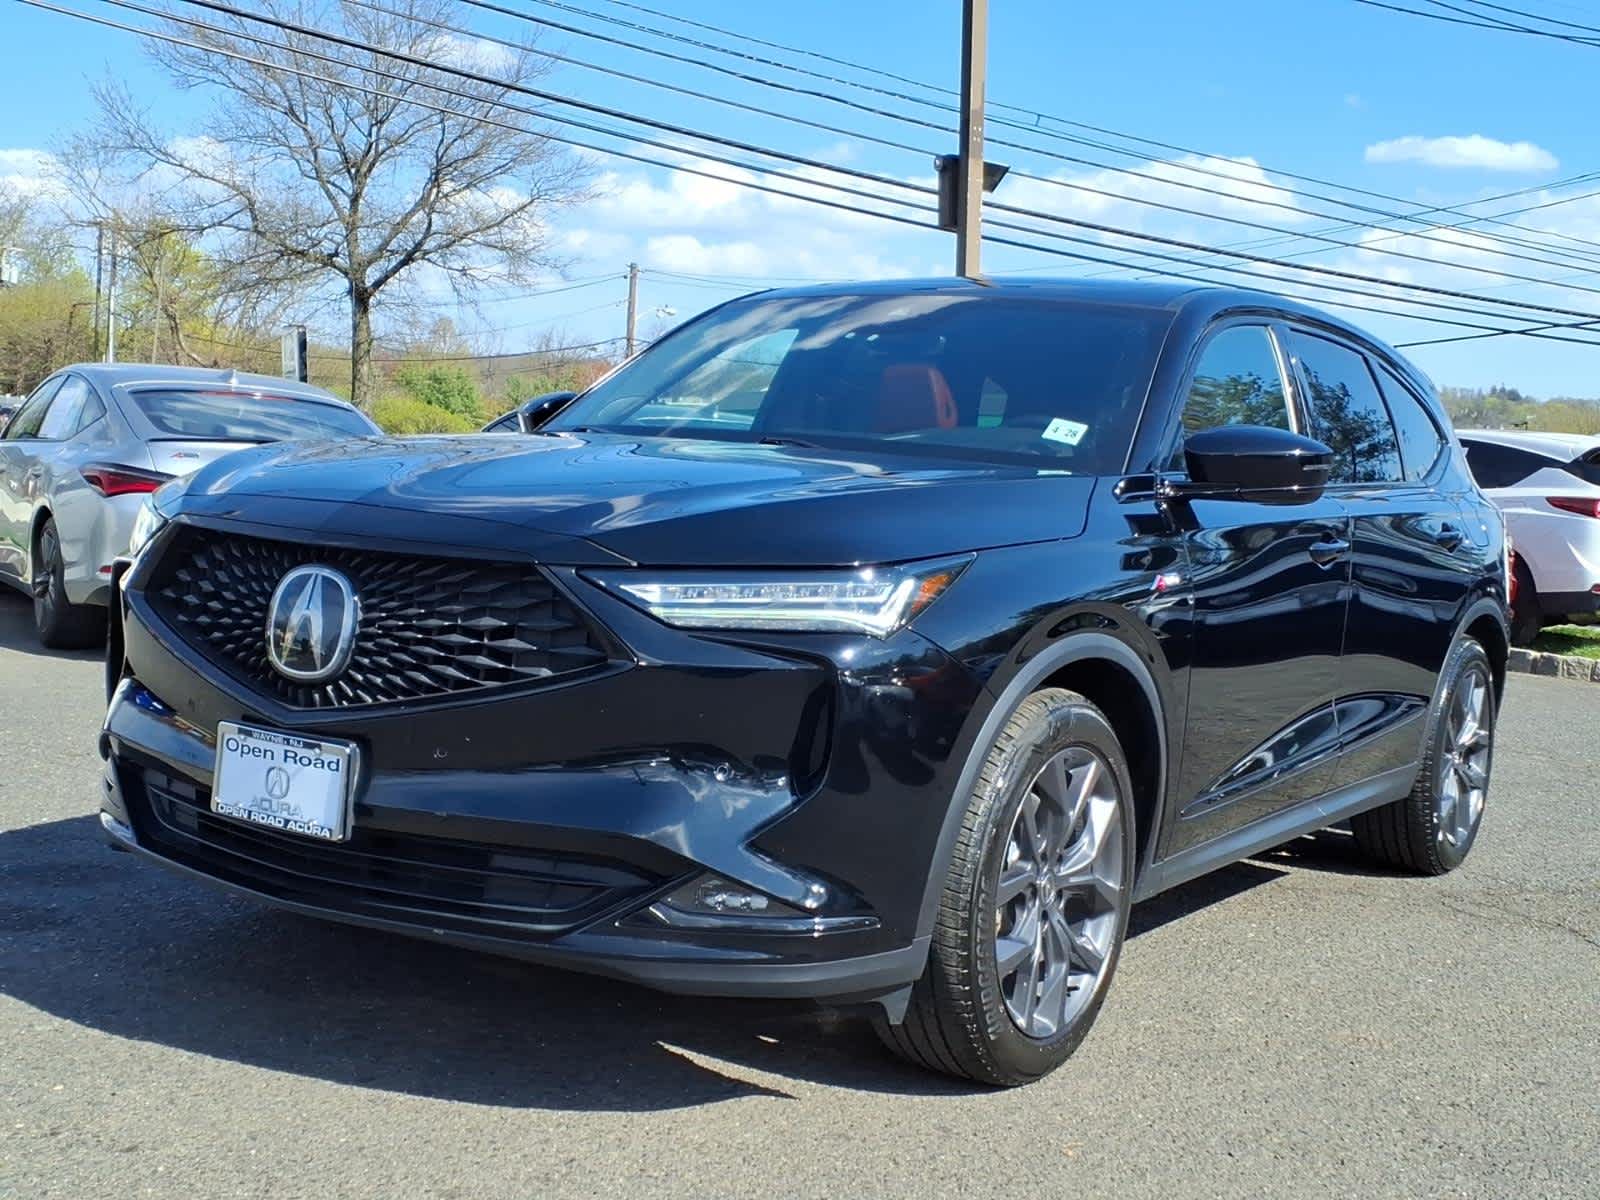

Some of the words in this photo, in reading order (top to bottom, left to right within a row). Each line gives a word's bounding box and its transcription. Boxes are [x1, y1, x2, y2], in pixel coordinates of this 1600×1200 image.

[225, 737, 275, 761] Open
[283, 749, 341, 773] Road
[217, 803, 249, 818] OPEN
[250, 811, 284, 827] ROAD
[287, 821, 330, 838] ACURA
[249, 797, 303, 817] ACURA
